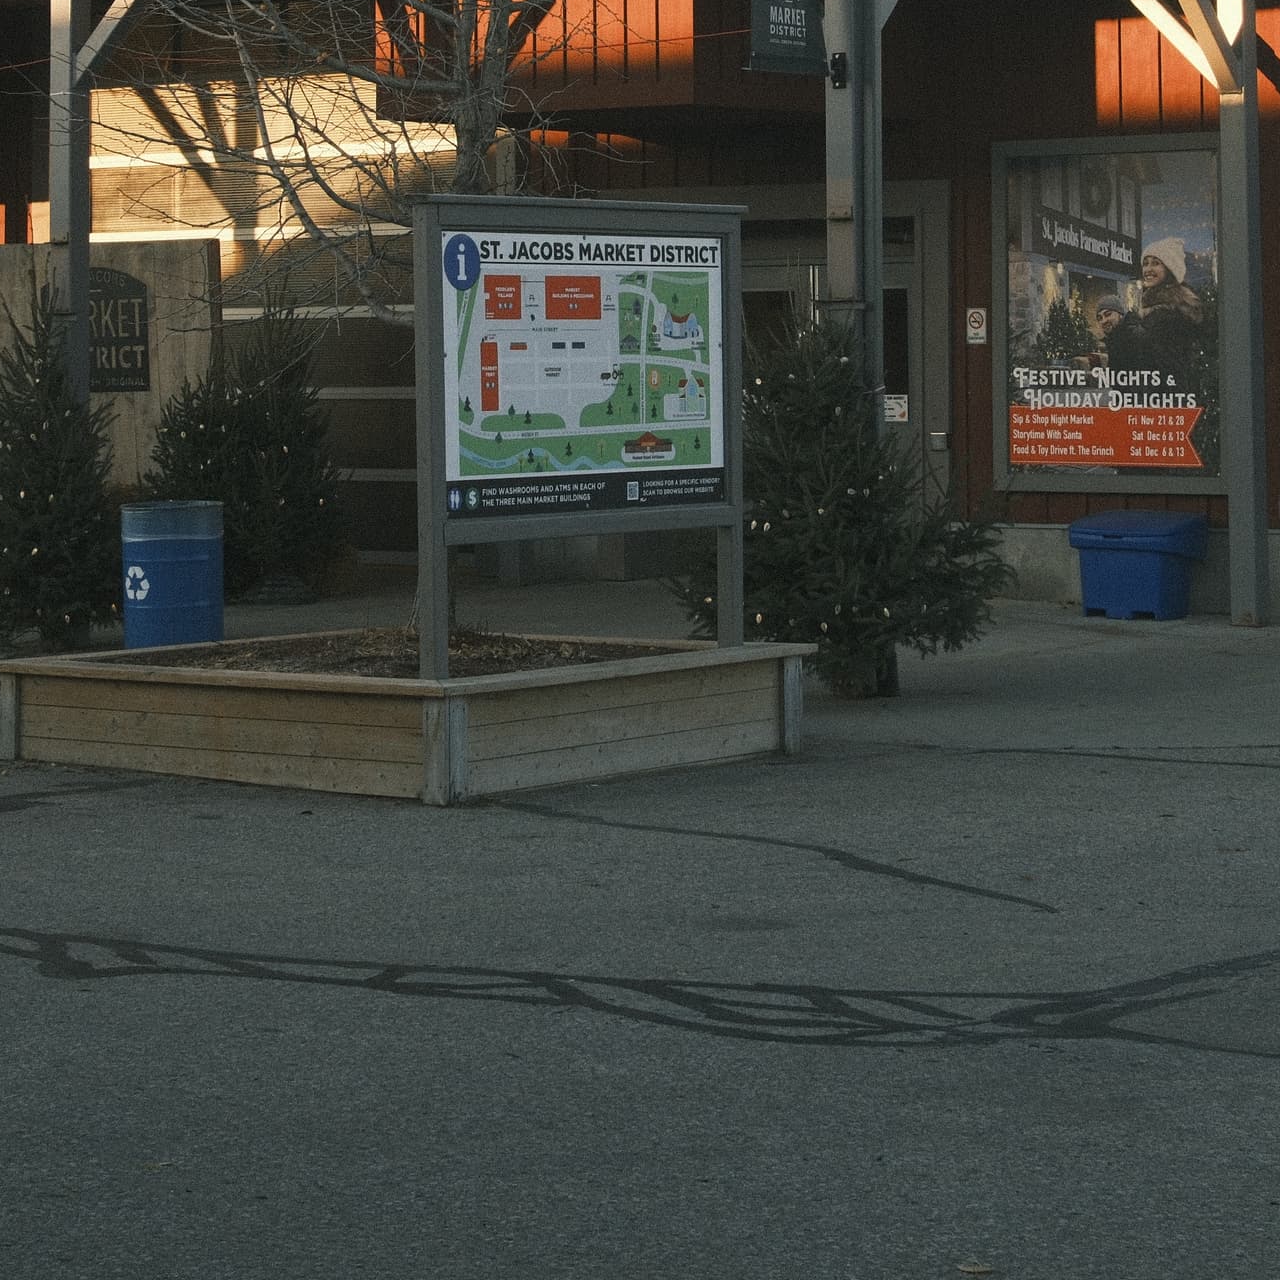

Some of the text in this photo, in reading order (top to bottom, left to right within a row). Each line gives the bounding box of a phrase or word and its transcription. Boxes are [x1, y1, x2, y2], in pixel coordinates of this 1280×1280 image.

[769, 6, 806, 26] MARKET
[769, 24, 807, 38] DISTRICT
[1053, 221, 1080, 248] Jacobs
[1110, 240, 1133, 265] Market
[480, 241, 719, 264] ST. JACOBS MARKET DISTRICT
[89, 299, 143, 337] RKET
[1166, 375, 1176, 386] &
[1012, 413, 1094, 426] Sip & Shop Night Market
[1127, 414, 1185, 426] Fri Nov 21 & 28
[1012, 429, 1082, 442] Storytime With Santa
[1131, 430, 1185, 441] Sat Dec 6 & 13
[1013, 444, 1029, 455] Food
[1030, 445, 1036, 454] &
[1037, 445, 1049, 457] Toy
[1050, 445, 1068, 455] Drive
[1078, 445, 1090, 456] The
[1091, 445, 1115, 456] Grinch
[1130, 446, 1185, 457] Sat Dec 6 & 13
[482, 488, 497, 496] FIND
[498, 486, 539, 495] WASHROOMS
[540, 485, 554, 493] AND
[572, 483, 579, 491] IN
[597, 482, 606, 490] OF
[664, 479, 674, 487] FOR
[664, 487, 683, 495] BROWSE
[482, 493, 591, 507] THE THREE MAIN MARKET BUILDINGS
